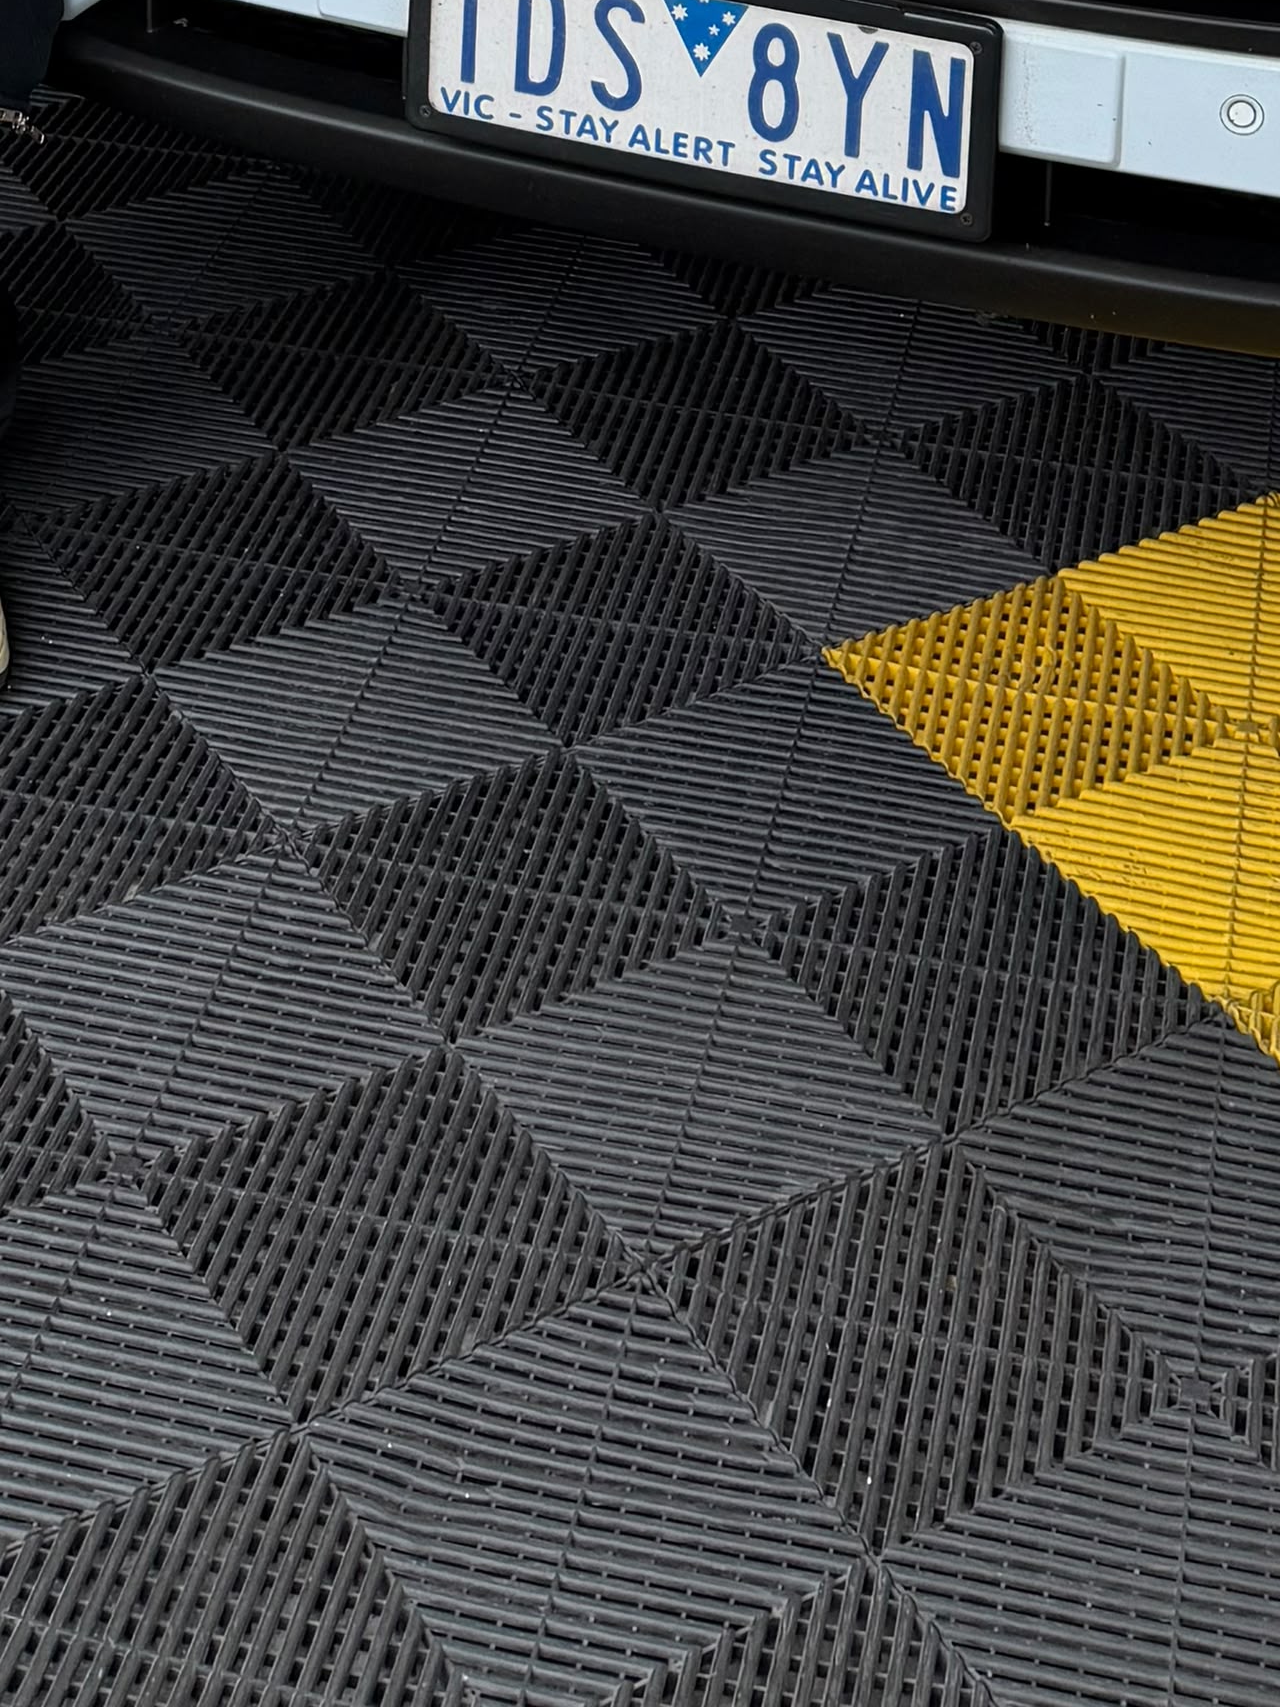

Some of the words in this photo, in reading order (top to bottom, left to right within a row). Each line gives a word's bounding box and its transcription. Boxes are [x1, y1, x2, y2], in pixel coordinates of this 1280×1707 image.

[439, 86, 495, 121] VIC
[535, 103, 620, 144] STAY
[628, 123, 736, 168] ALERT
[757, 148, 846, 190] STAY
[854, 168, 959, 213] ALIVE
[747, 22, 967, 179] 8YN
